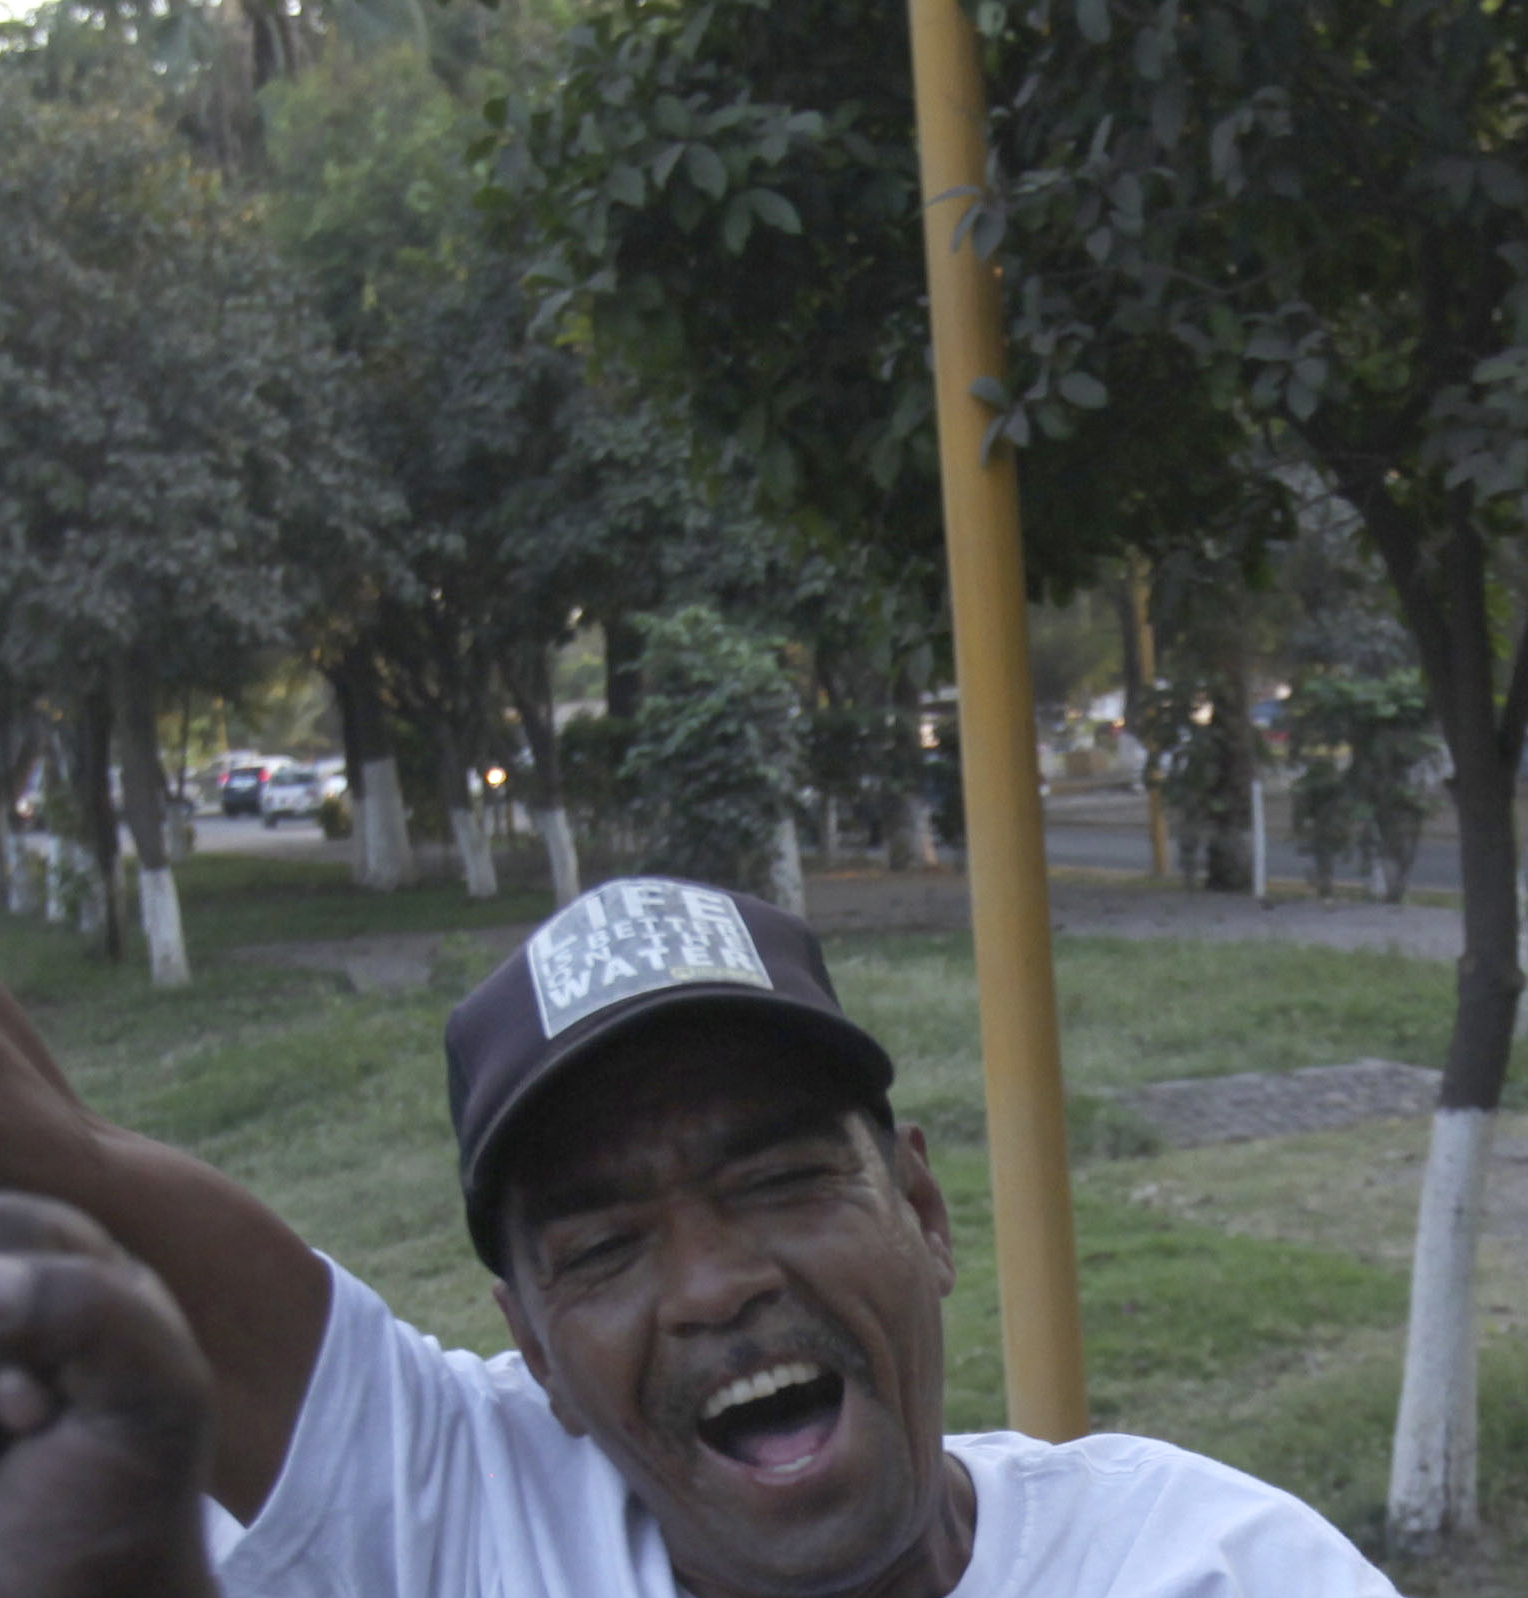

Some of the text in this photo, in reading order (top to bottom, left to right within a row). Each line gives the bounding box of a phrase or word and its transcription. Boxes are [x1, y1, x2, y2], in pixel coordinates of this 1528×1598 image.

[534, 886, 732, 959] LIFE
[586, 916, 741, 950] BETTER
[549, 947, 758, 1009] WATER
